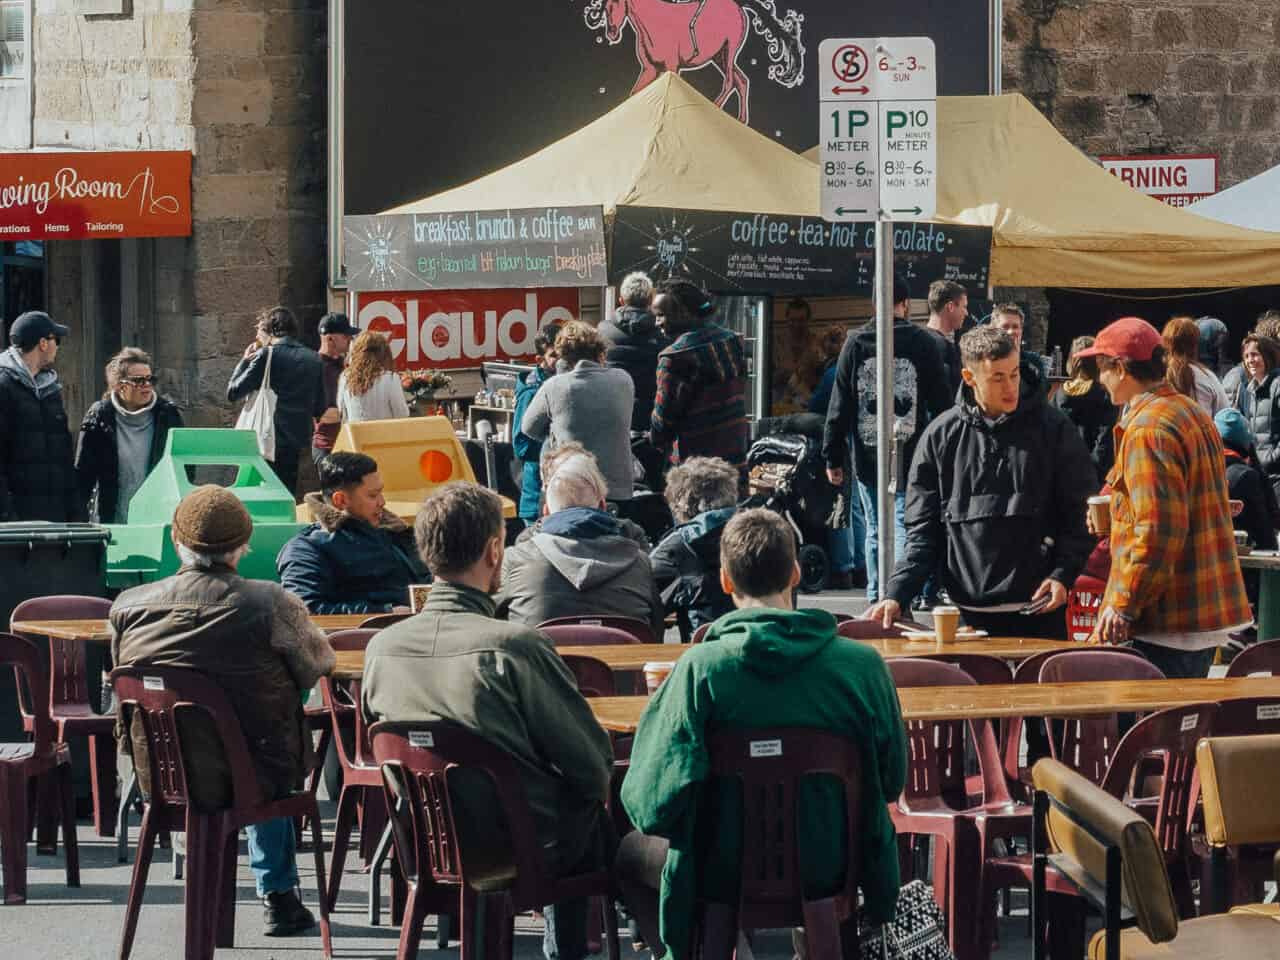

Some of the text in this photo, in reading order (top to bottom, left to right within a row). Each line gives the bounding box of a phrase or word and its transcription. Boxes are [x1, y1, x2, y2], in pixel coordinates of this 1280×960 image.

[893, 73, 909, 82] SUN
[827, 141, 870, 152] METER
[887, 141, 928, 151] METER
[51, 168, 127, 200] Room
[827, 179, 846, 188] MON
[856, 179, 873, 187] SAT
[887, 179, 905, 187] MON
[914, 179, 930, 187] SAT
[45, 223, 70, 232] Hems
[86, 222, 124, 232] Tailoring
[475, 208, 515, 240] brunch
[520, 217, 528, 239] &
[532, 208, 574, 242] coffee
[577, 216, 597, 230] BAR
[731, 215, 788, 247] coffee
[797, 216, 824, 246] tea
[829, 222, 858, 248] hot
